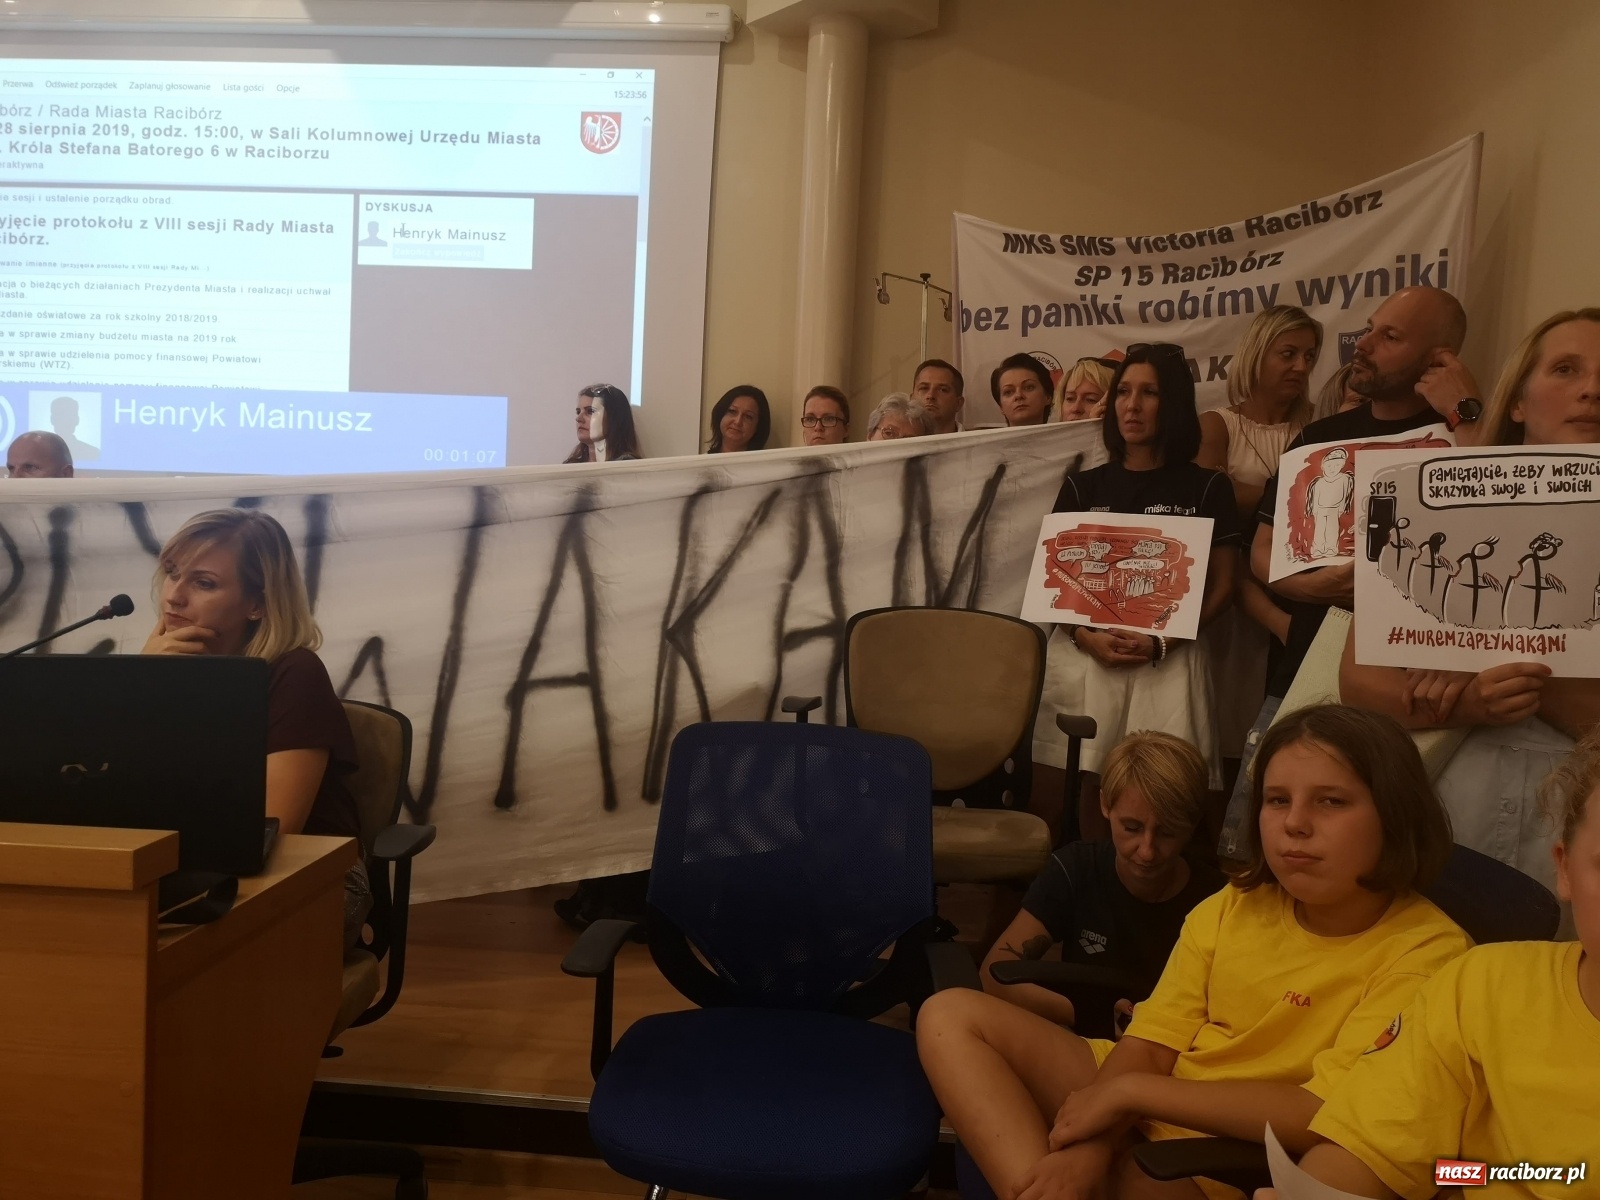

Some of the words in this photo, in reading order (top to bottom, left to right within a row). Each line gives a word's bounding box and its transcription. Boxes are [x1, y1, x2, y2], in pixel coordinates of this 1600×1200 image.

[2, 79, 34, 88] Przerwa
[45, 80, 78, 89] Odśwież
[80, 81, 118, 91] porządek
[129, 81, 164, 91] Zaplanuj
[165, 82, 211, 92] głosowanie
[223, 83, 241, 91] Lista
[243, 83, 265, 93] gości
[276, 84, 300, 93] Opcje
[613, 90, 647, 99] 15:23:56
[38, 104, 43, 117] /
[50, 104, 89, 118] Rada
[95, 105, 147, 119] Miasta
[154, 106, 222, 120] Racibórz
[18, 122, 86, 138] sierpnia
[92, 123, 135, 138] 2019,
[141, 125, 187, 139] godz.
[194, 125, 244, 140] 15:00,
[250, 129, 263, 139] w
[269, 127, 301, 140] Sali
[307, 128, 413, 145] Kolumnowej
[420, 129, 480, 146] Urzędu
[487, 131, 541, 145] Miasta
[9, 141, 52, 154] Króla
[59, 141, 121, 155] Stefana
[128, 143, 204, 159] Batorego
[210, 145, 219, 157] 6
[225, 147, 238, 158] w
[245, 145, 329, 160] Raciborzu
[12, 194, 35, 203] sesji
[45, 194, 90, 203] ustalenie
[93, 195, 139, 205] porządku
[365, 202, 433, 213] DYSKUSJA
[53, 216, 133, 230] protokołu
[139, 219, 148, 229] z
[154, 217, 181, 230] VIII
[187, 219, 227, 233] sesji
[233, 219, 274, 235] Rady
[281, 220, 334, 234] Miasta
[1002, 232, 1056, 254] MKS
[1059, 235, 1117, 256] SMS
[1125, 225, 1235, 254] Victoria
[1244, 190, 1383, 238] Racibórz
[0, 232, 50, 245] ibórz.
[393, 226, 441, 241] Henryk
[448, 229, 506, 241] Mainusz
[25, 259, 57, 267] imienne
[1074, 265, 1112, 287] SP
[1162, 250, 1285, 285] Racibórz
[30, 280, 80, 291] bieżących
[84, 281, 140, 291] działaniach
[144, 282, 200, 294] Prezydenta
[204, 284, 236, 293] Miasta
[247, 285, 293, 296] realizacji
[960, 300, 1009, 333] bez
[1021, 294, 1125, 337] paniki
[1139, 283, 1280, 325] robimy
[1295, 248, 1449, 309] wyniki
[36, 310, 86, 320] oświatowe
[89, 312, 101, 320] za
[105, 311, 121, 321] rok
[124, 311, 161, 323] szkolny
[19, 330, 57, 339] sprawie
[60, 331, 95, 341] zmiany
[141, 333, 173, 342] miasta
[177, 334, 189, 342] na
[193, 334, 217, 343] 2019
[19, 350, 57, 359] sprawie
[60, 350, 110, 360] udzielenia
[114, 353, 153, 362] pomocy
[156, 353, 208, 363] finansowej
[212, 354, 262, 364] Powiatowi
[115, 398, 226, 432] Henryk
[239, 402, 373, 432] Mainusz
[424, 448, 496, 464] 00:01:07
[1174, 504, 1196, 515] team
[1080, 928, 1108, 946] arena
[1282, 990, 1311, 1008] FKA
